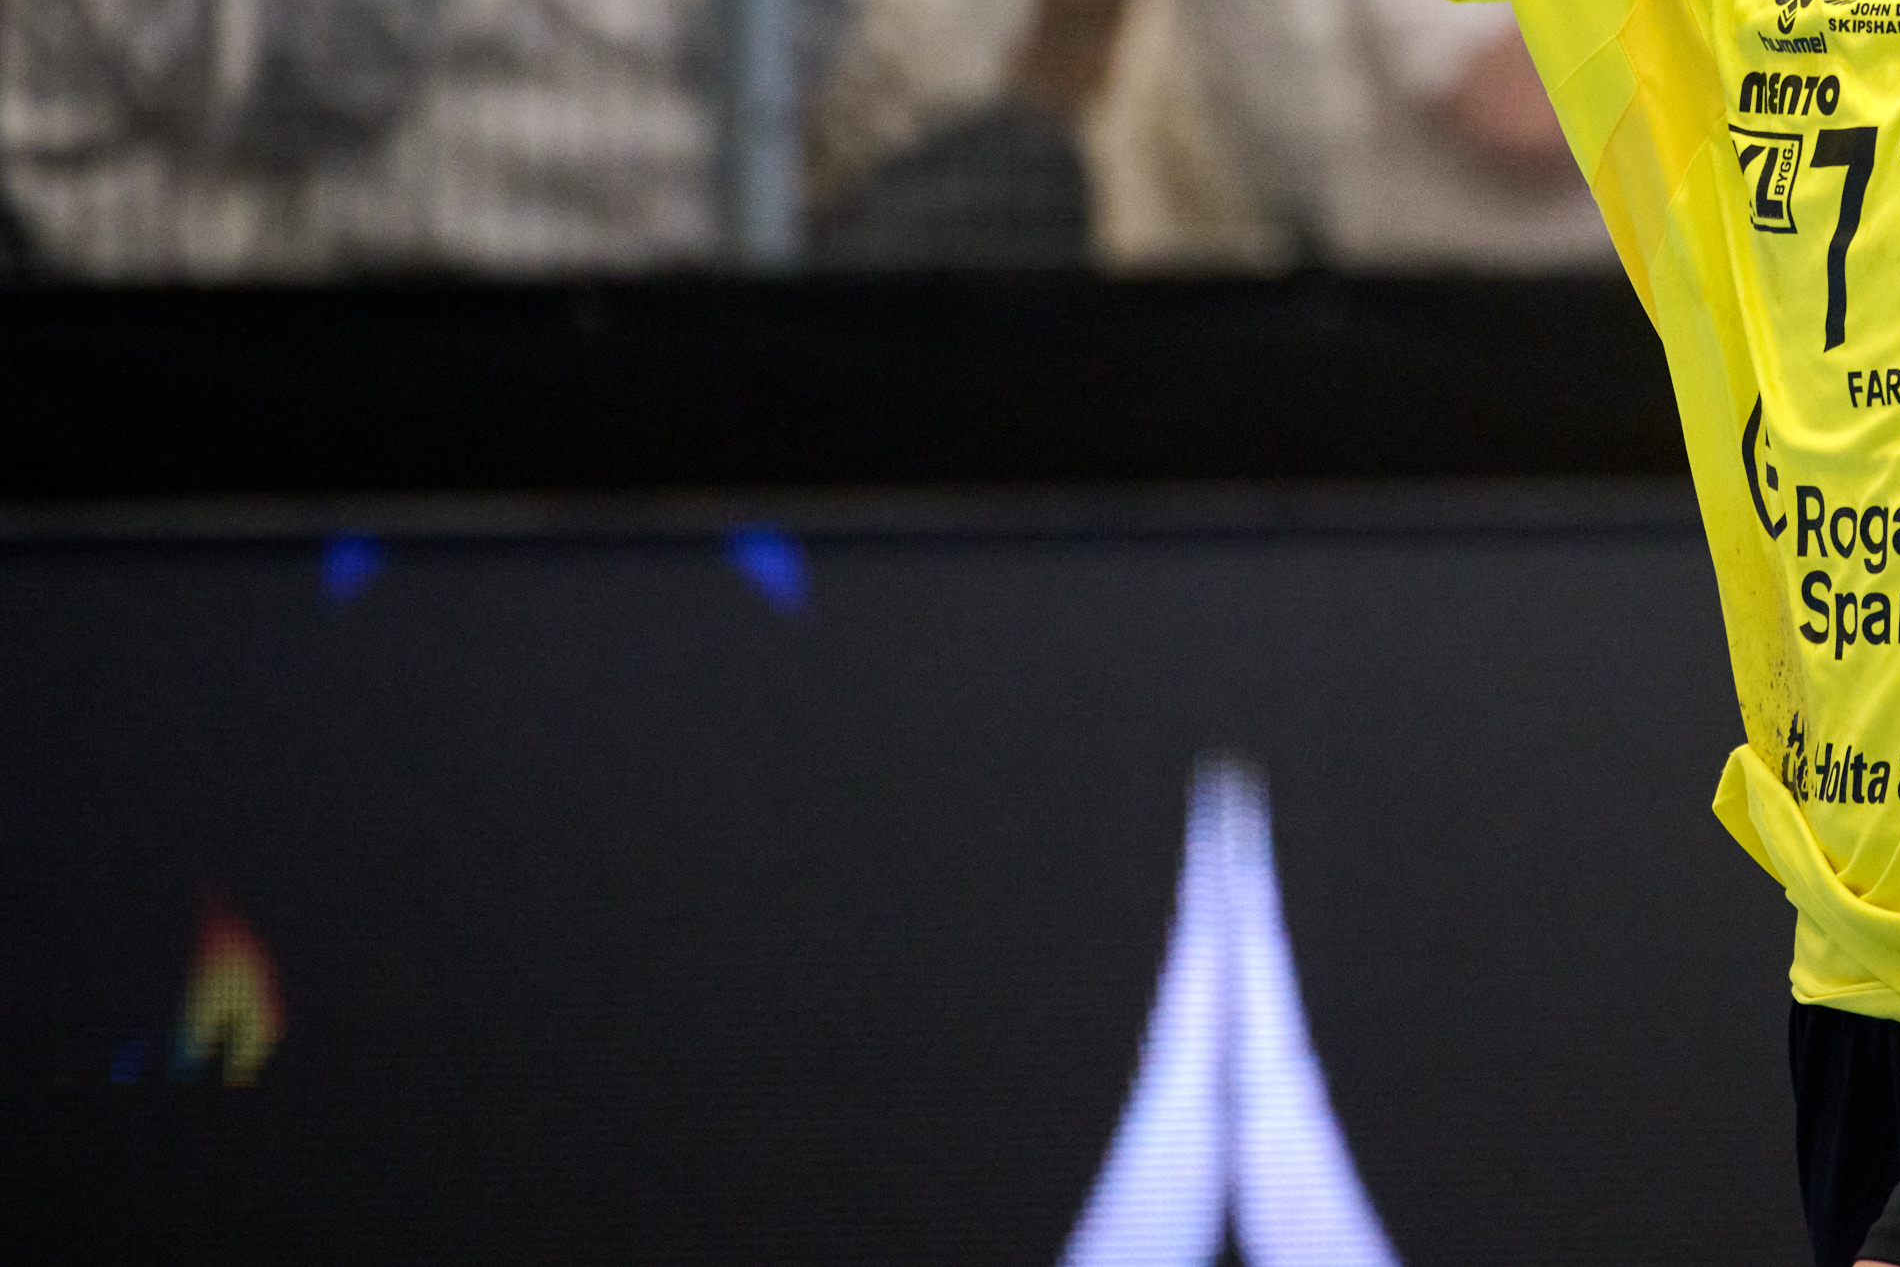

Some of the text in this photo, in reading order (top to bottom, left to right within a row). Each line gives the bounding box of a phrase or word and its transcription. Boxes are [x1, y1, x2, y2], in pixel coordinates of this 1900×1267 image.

[1851, 2, 1892, 17] JOHN
[1758, 31, 1827, 54] hummel
[1815, 741, 1891, 804] Holta
